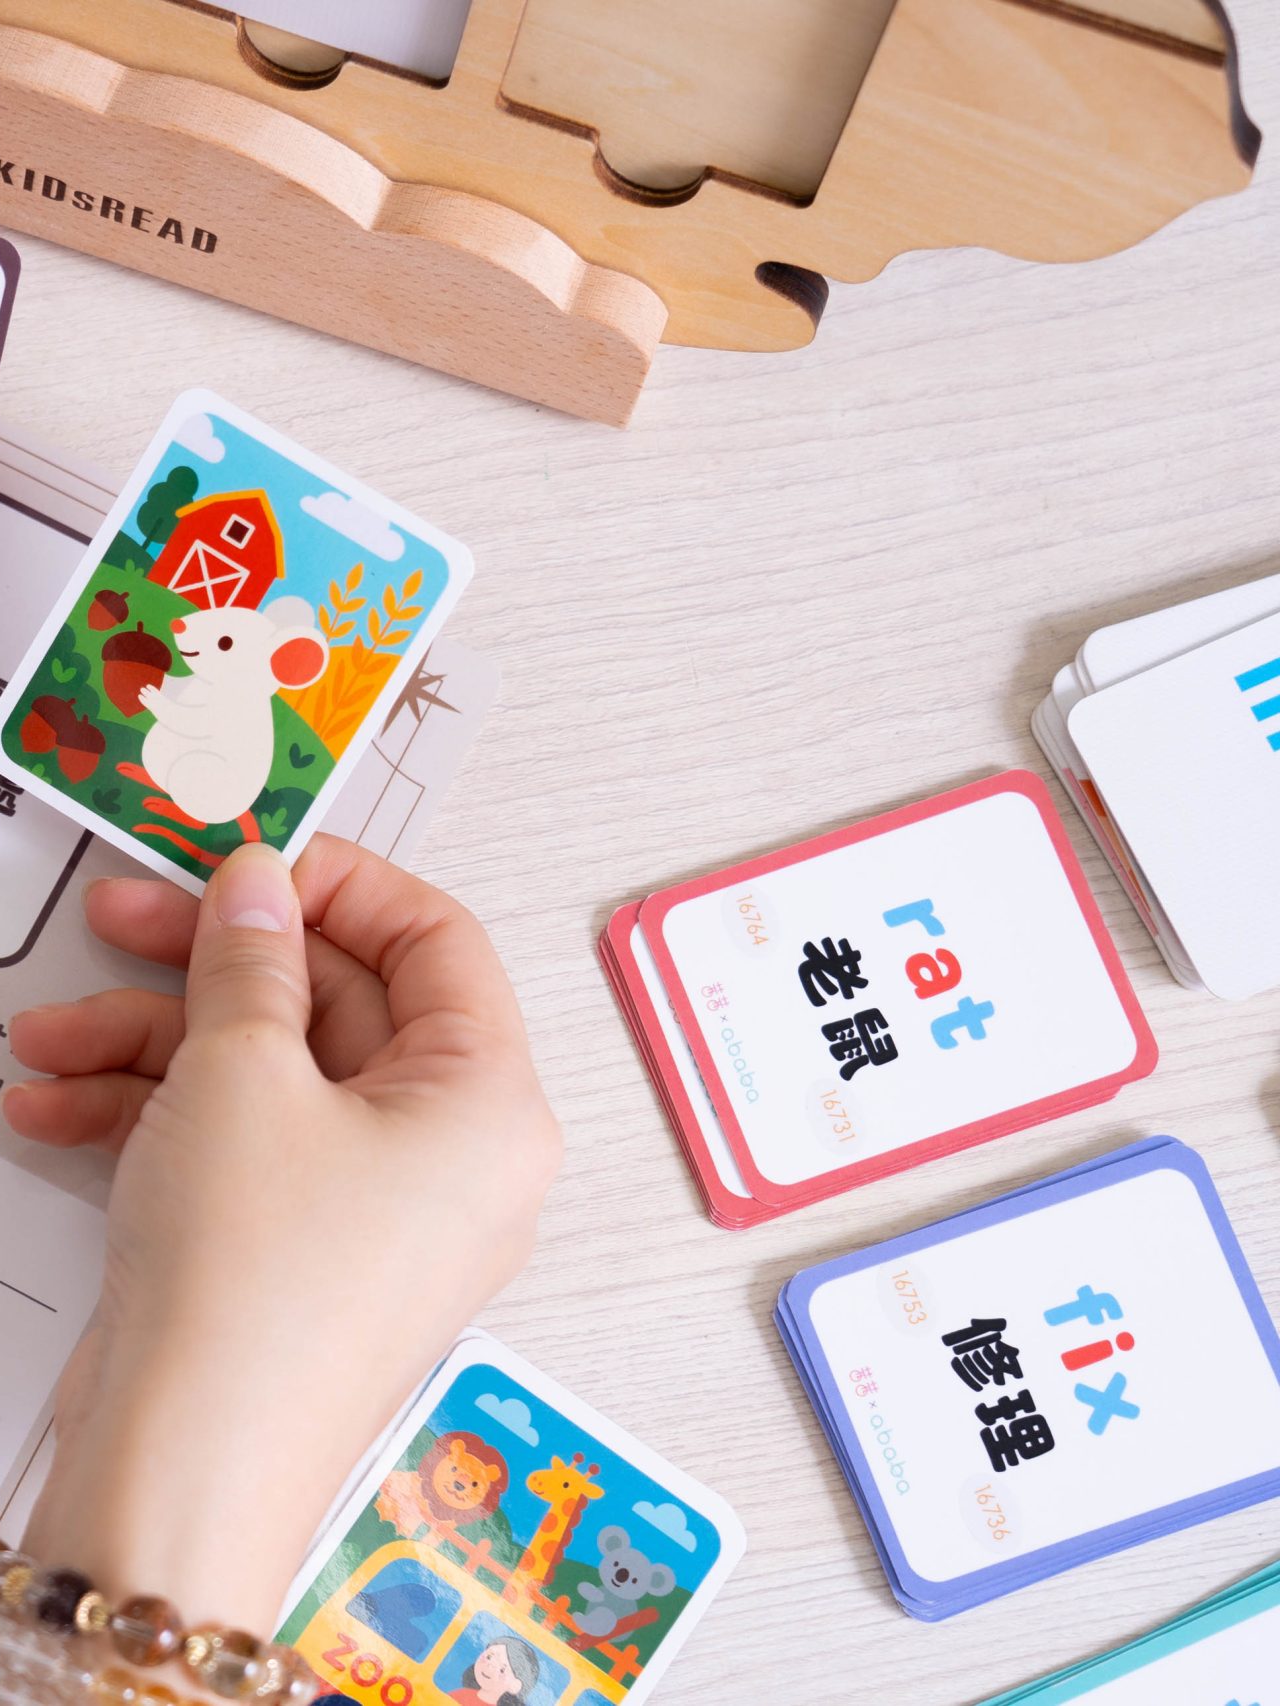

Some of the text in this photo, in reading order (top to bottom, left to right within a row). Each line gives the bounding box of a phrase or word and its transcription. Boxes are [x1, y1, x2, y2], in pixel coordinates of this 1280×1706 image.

[736, 893, 770, 947] 16764
[797, 936, 900, 1082] 老鼠
[881, 897, 996, 1050] rat
[819, 1088, 856, 1144] 16731
[891, 1269, 928, 1327] 16753
[941, 1316, 1056, 1473] 修理
[1043, 1284, 1141, 1436] fix
[973, 1483, 1012, 1542] 16736
[322, 1632, 414, 1706] ZOO
